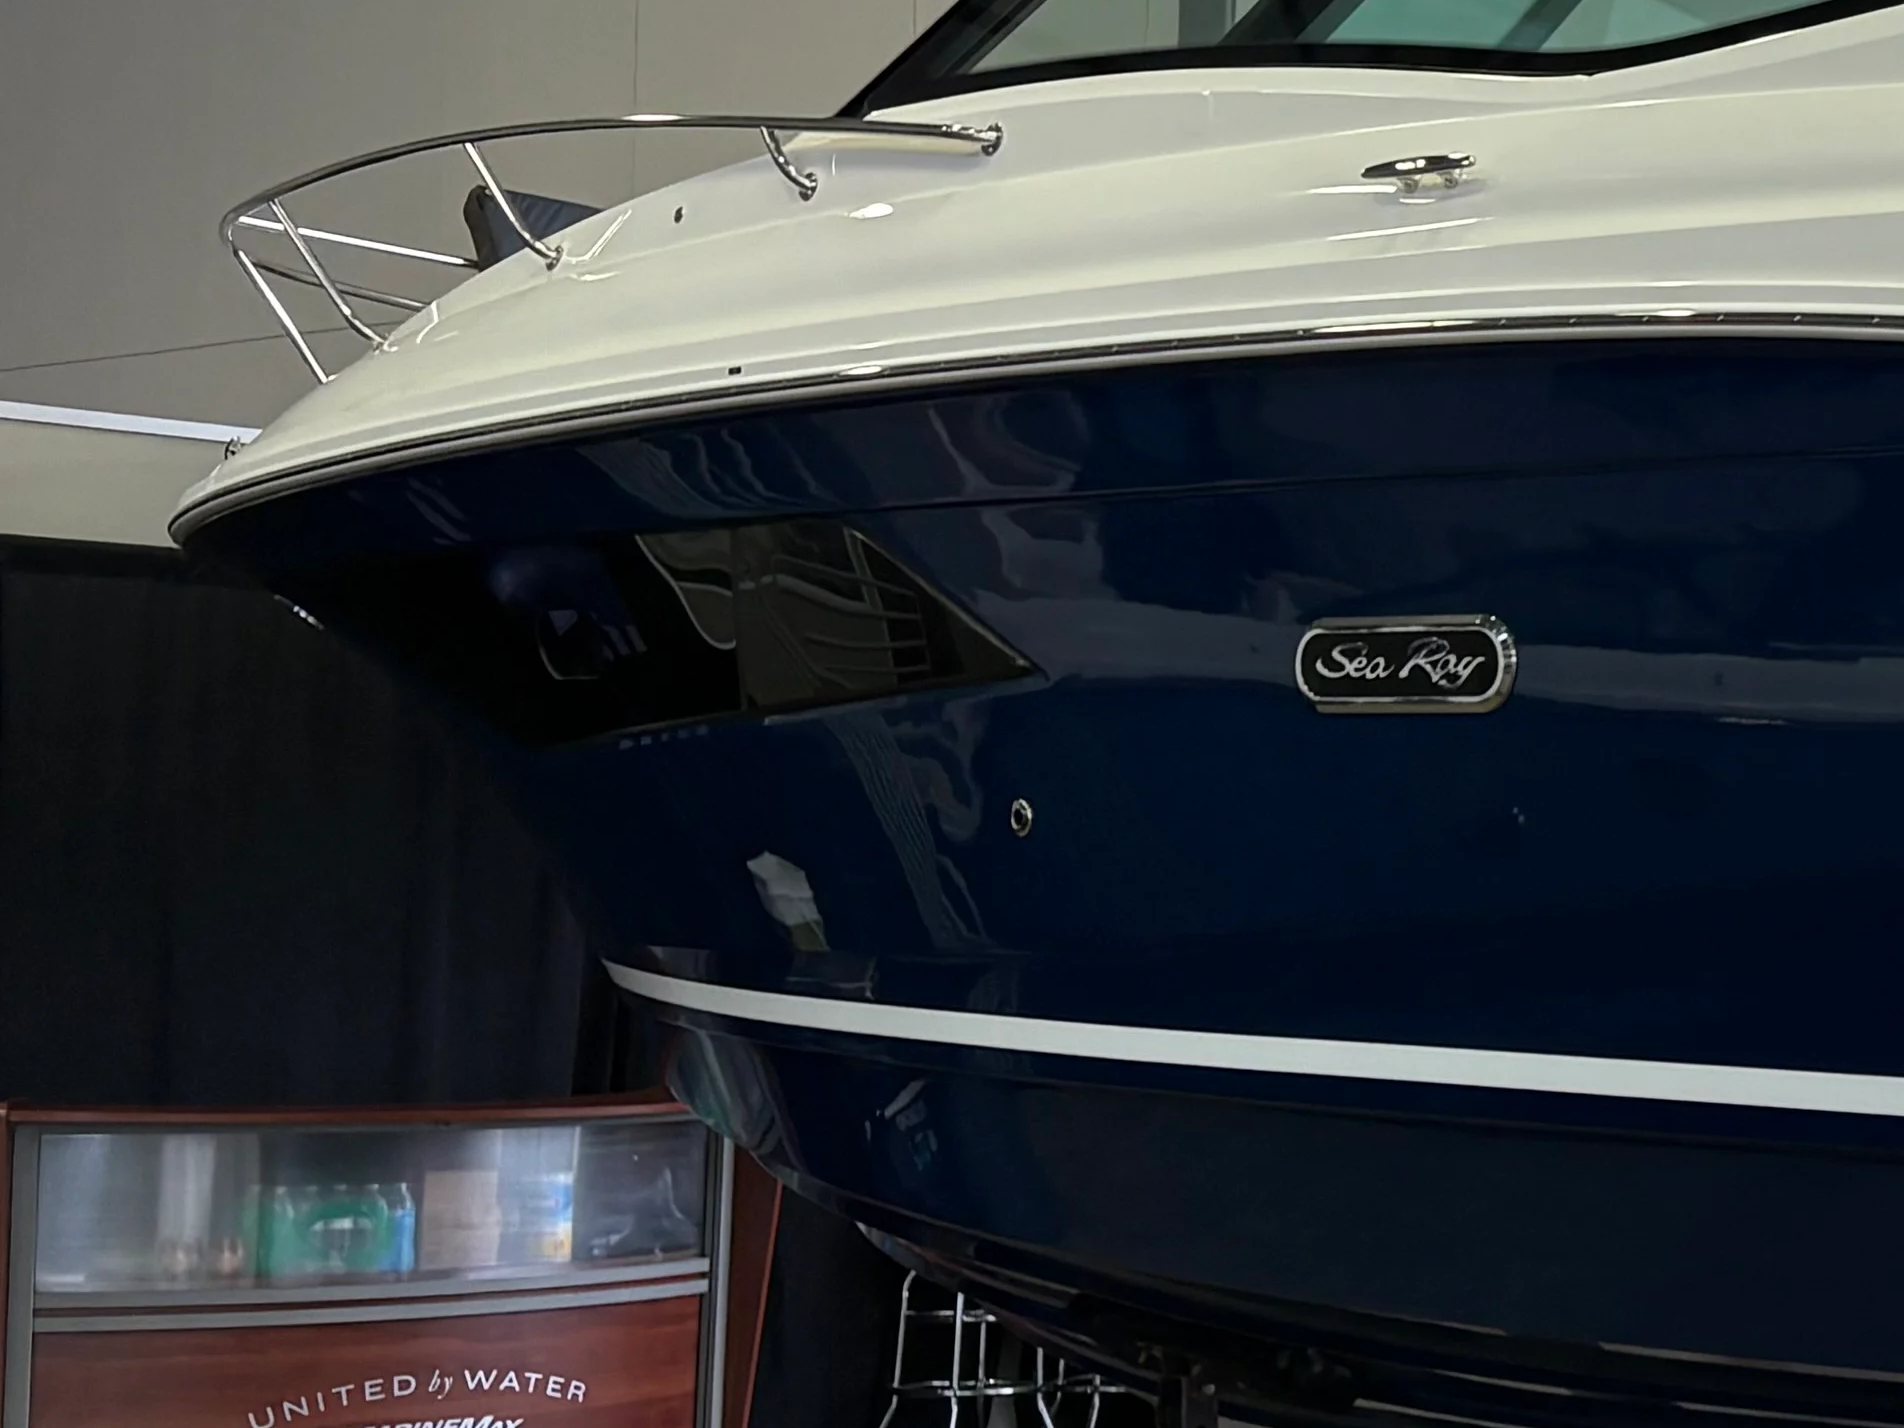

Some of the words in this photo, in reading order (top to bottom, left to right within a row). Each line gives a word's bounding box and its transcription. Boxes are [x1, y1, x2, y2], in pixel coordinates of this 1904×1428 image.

[1315, 640, 1396, 680] Sea
[1398, 635, 1486, 690] Ray
[427, 1368, 454, 1400] by
[463, 1368, 587, 1404] WATER
